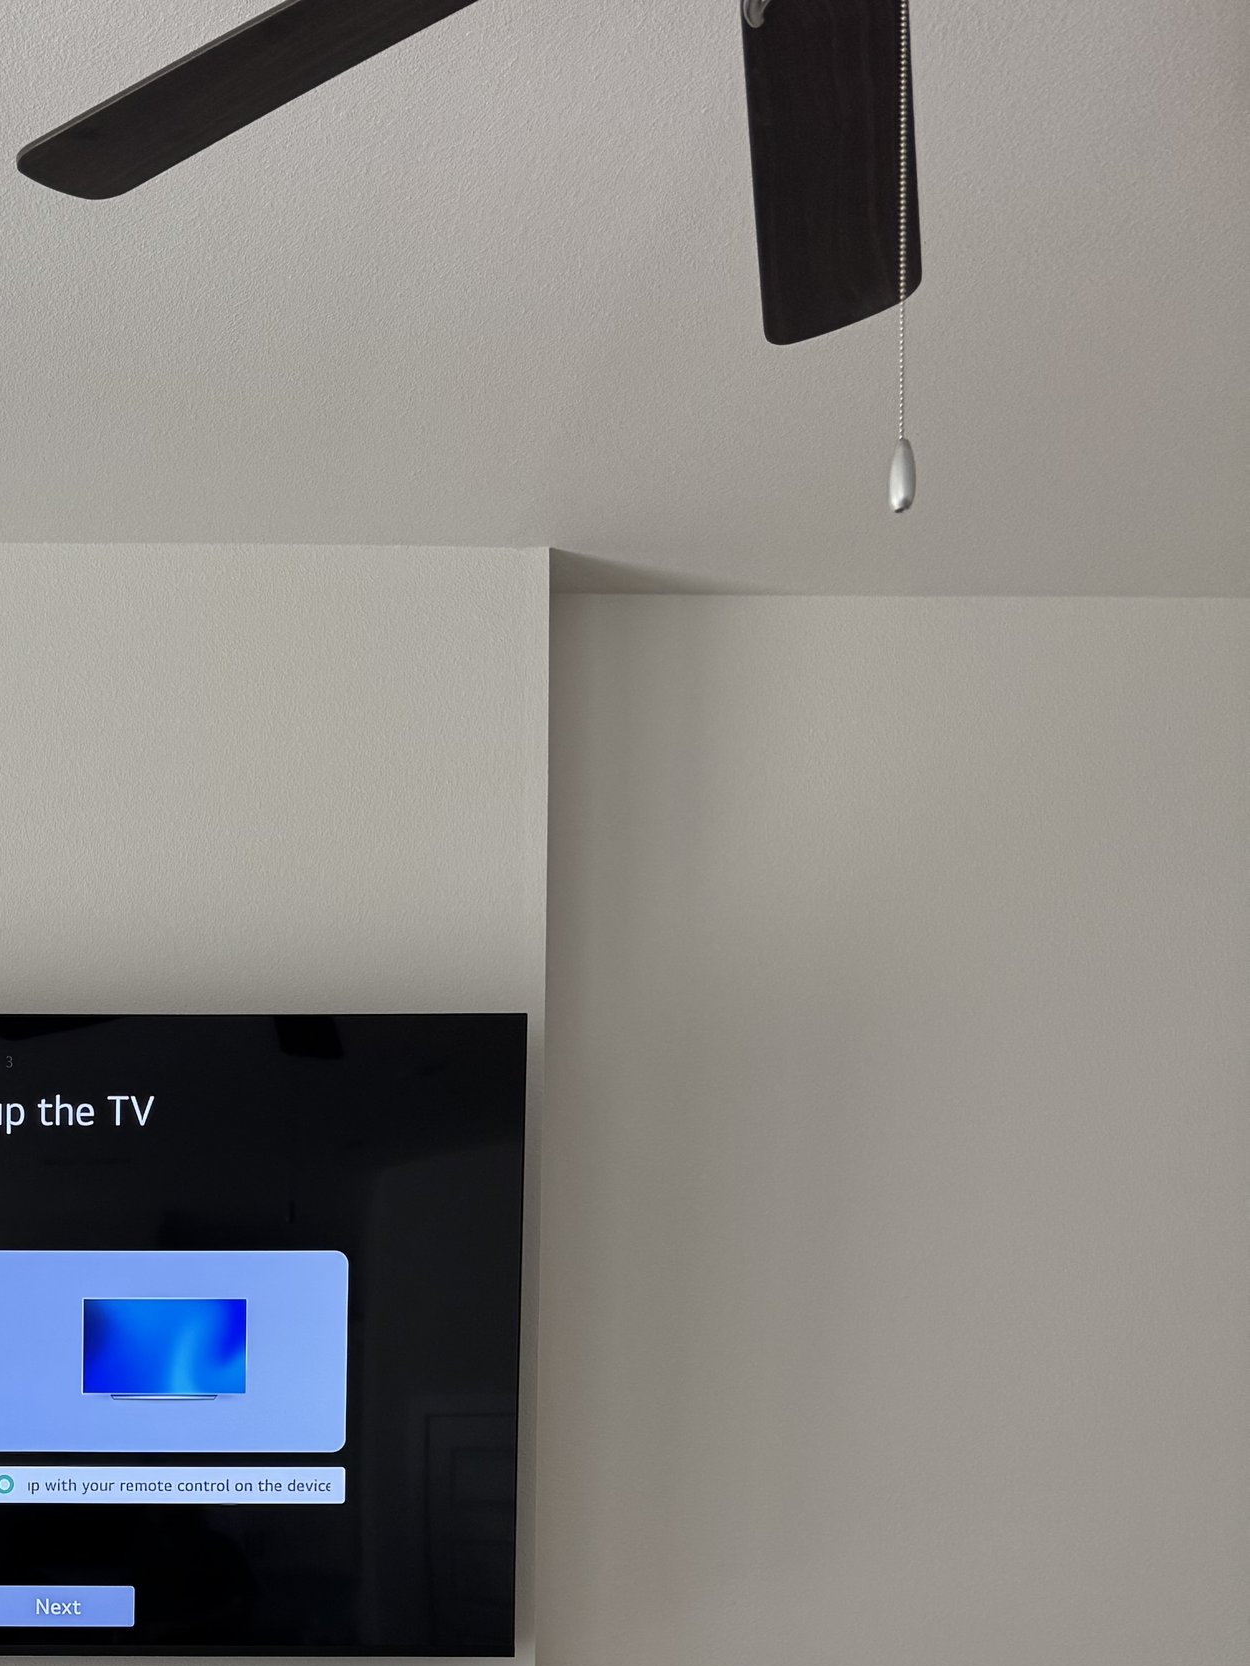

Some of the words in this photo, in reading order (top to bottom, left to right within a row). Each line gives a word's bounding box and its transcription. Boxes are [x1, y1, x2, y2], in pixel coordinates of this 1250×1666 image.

[5, 1055, 14, 1068] 3
[37, 1094, 95, 1127] the
[106, 1095, 155, 1127] TV
[44, 1478, 77, 1492] with
[81, 1482, 116, 1496] your
[120, 1480, 173, 1492] remote
[177, 1478, 230, 1492] control
[234, 1482, 253, 1492] on
[257, 1478, 283, 1492] the
[287, 1478, 332, 1492] device
[36, 1598, 82, 1616] Next
